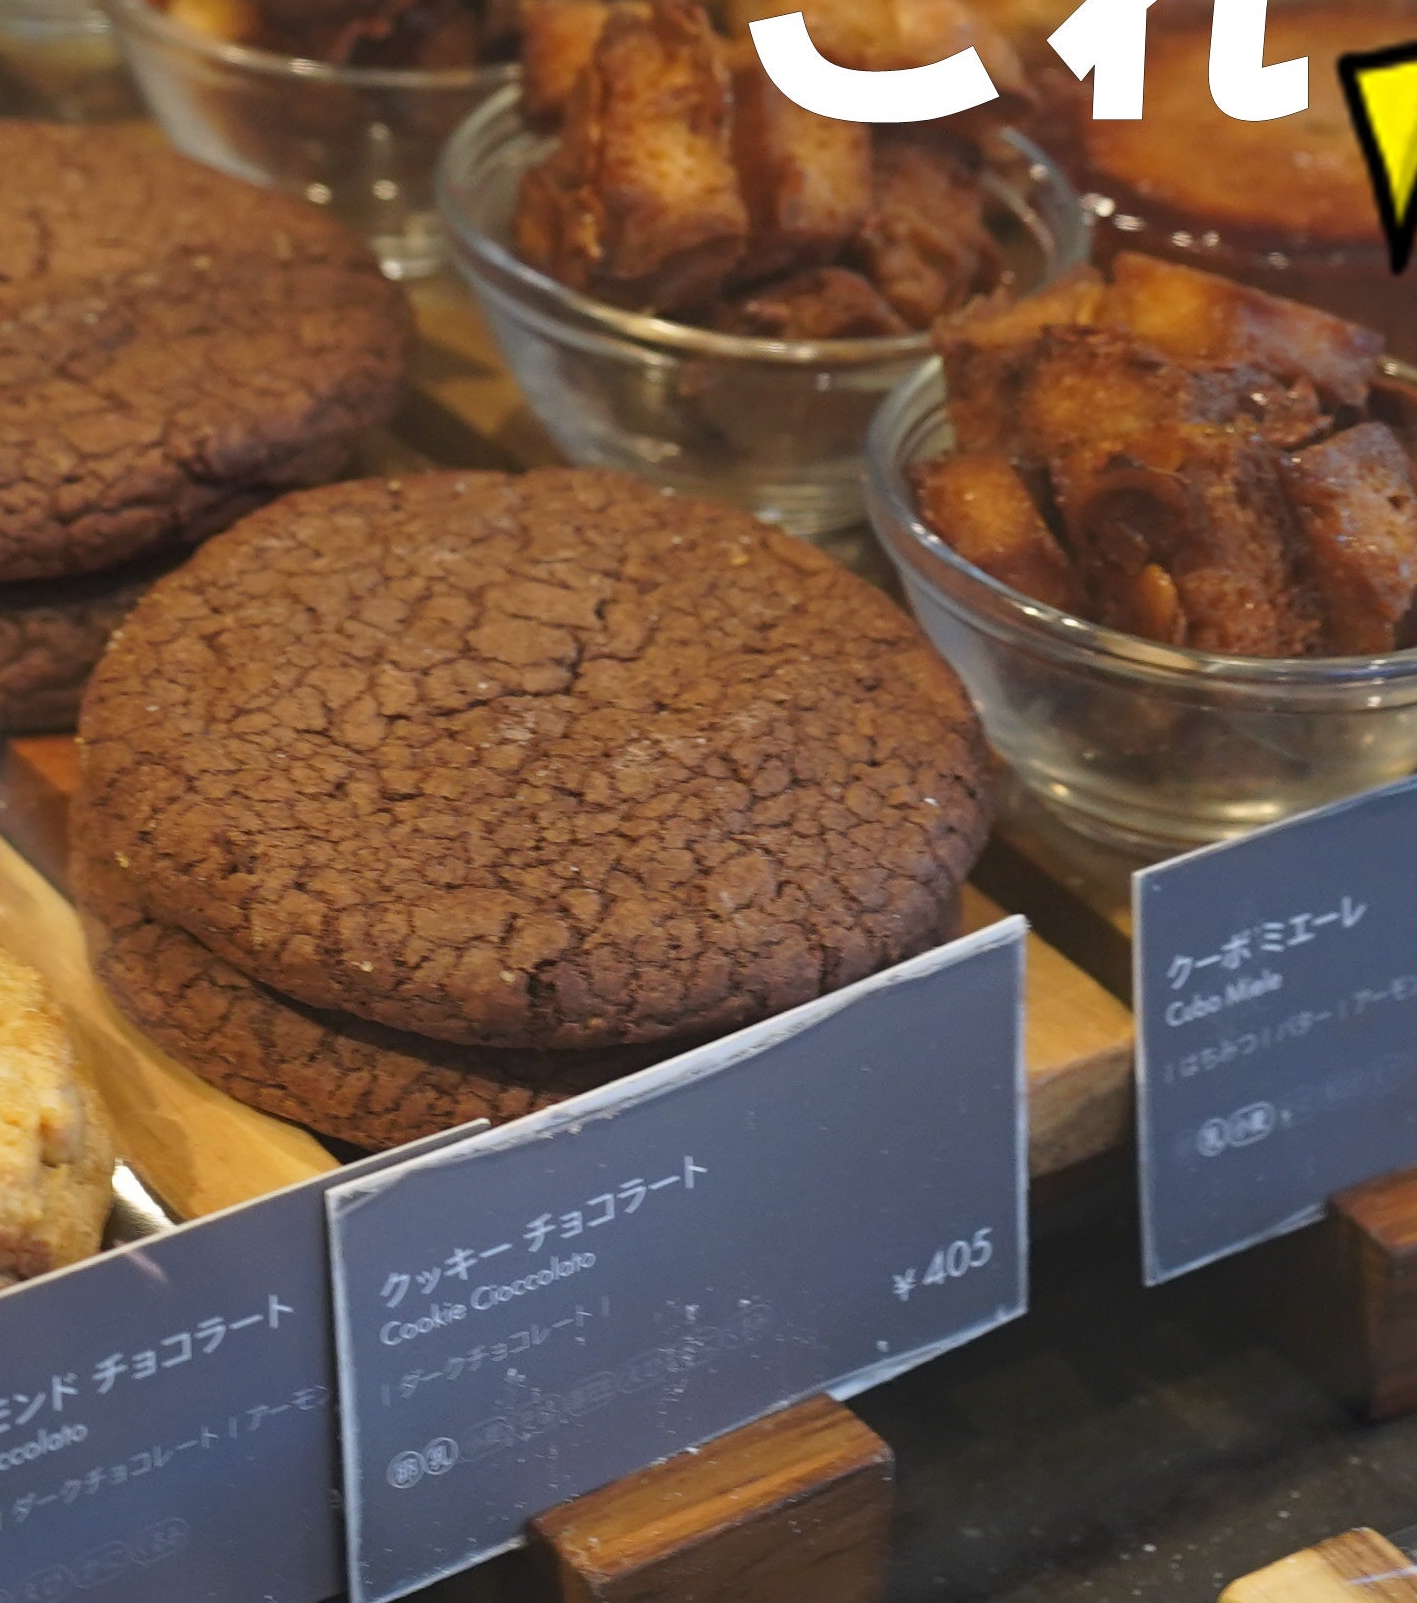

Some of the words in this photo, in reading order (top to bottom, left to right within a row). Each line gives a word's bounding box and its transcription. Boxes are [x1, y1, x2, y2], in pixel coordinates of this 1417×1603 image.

[380, 1240, 511, 1308] クッキー
[523, 1154, 708, 1255] チョコラート
[92, 1294, 294, 1394] チョコラート
[380, 1300, 467, 1346] Cookie
[470, 1248, 597, 1312] Cioccolato
